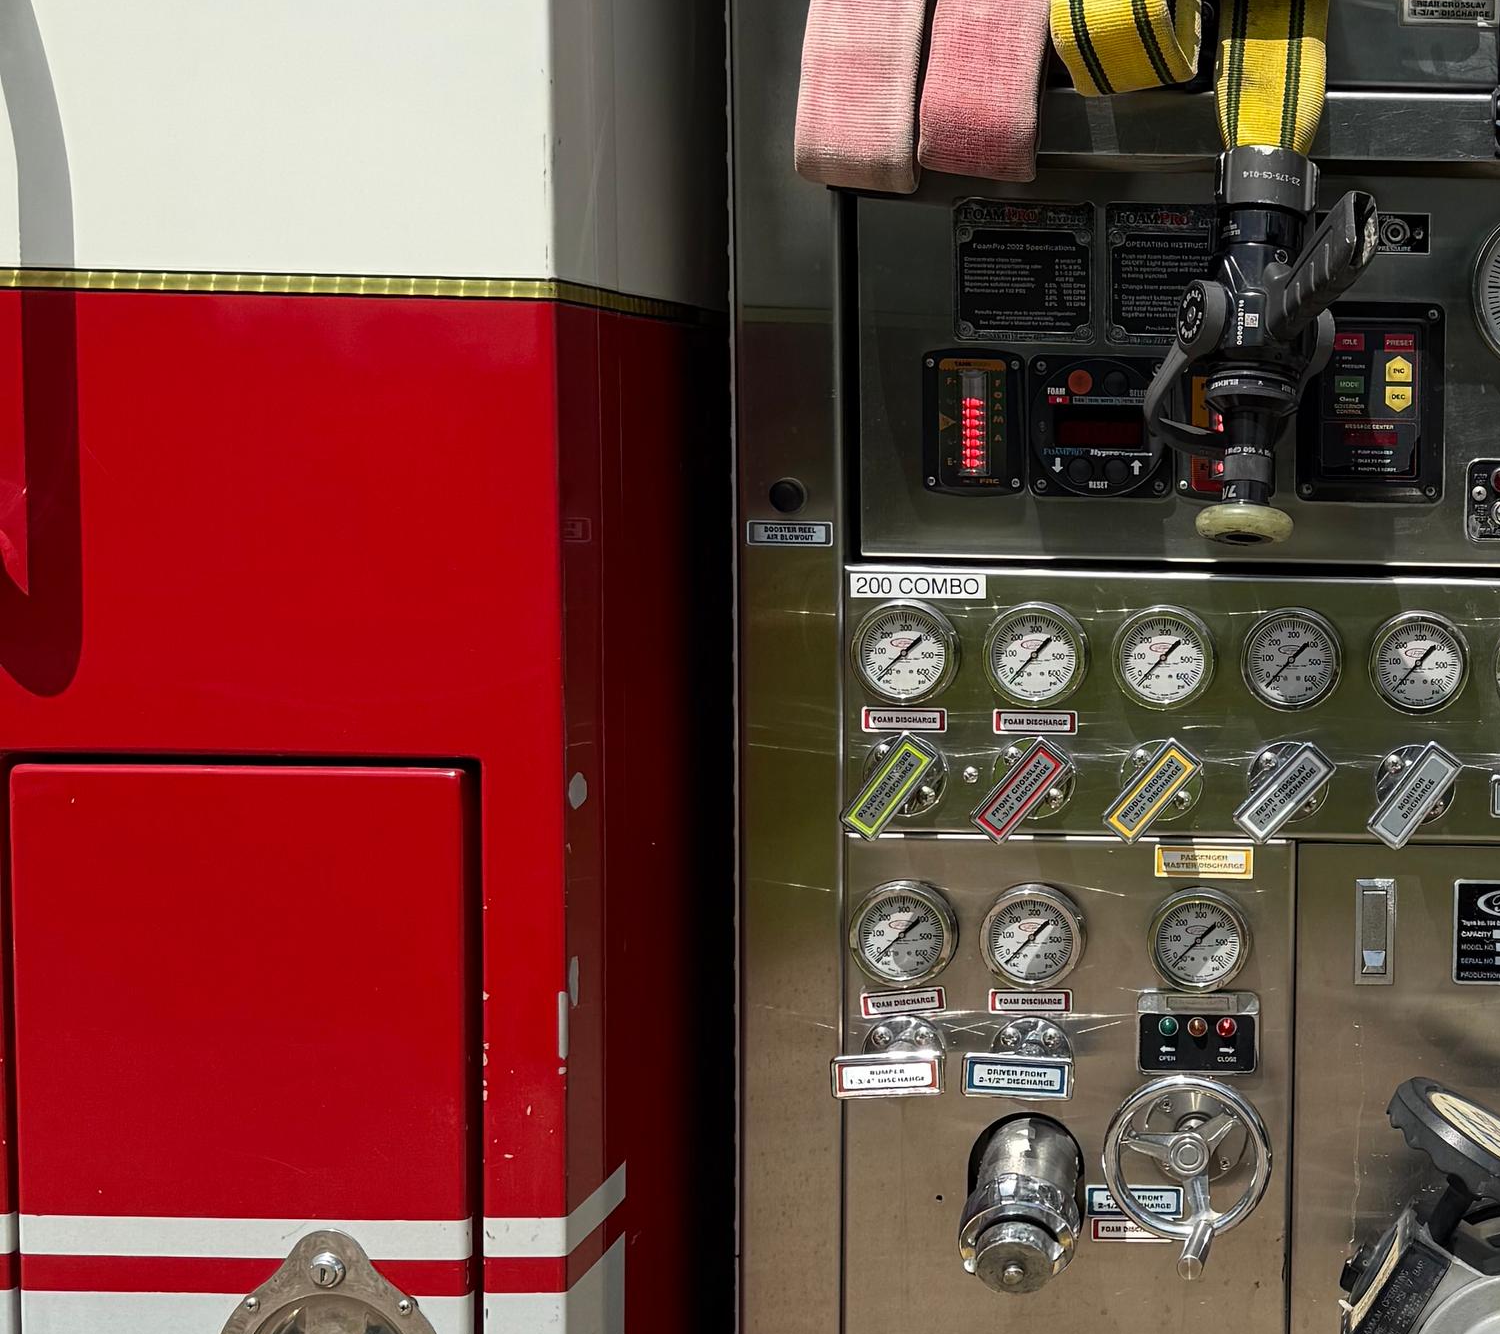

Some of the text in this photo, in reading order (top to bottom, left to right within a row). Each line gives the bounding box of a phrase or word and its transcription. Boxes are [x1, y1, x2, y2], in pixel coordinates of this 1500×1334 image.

[1416, 0, 1487, 9] REAR CROSSLAY
[1439, 9, 1490, 18] DISCHARGE
[1342, 338, 1358, 346] IDLE
[1386, 339, 1413, 347] PRESET
[1392, 367, 1405, 375] INC
[1339, 380, 1360, 389] MODE
[1047, 387, 1066, 396] FOAM
[1391, 393, 1406, 401] DEC
[1089, 481, 1108, 490] RESET
[798, 526, 816, 534] REEL
[856, 577, 979, 596] 200 COMBO
[872, 716, 938, 724] FOAM DISCHARGE
[1026, 718, 1068, 726] DISCHARGE
[885, 761, 915, 799] DISCHARGE
[1016, 765, 1050, 803] DISCHARGE
[1147, 765, 1182, 803] DISCHARGE
[991, 759, 1043, 818] FRONT CROSSLAY
[1121, 759, 1176, 819] MIDDLE CROSSLAY
[1255, 765, 1307, 816] REAR CROSSLAY
[1278, 767, 1317, 806] DISCHARGE
[858, 778, 889, 818] PASSENGER
[1398, 777, 1427, 811] MONITOR
[1402, 779, 1435, 819] DISCHARGE
[1180, 854, 1228, 862] PASSENGER
[1164, 861, 1245, 870] MASTER DISCHARGE
[1461, 930, 1491, 938] CAPACITY
[871, 996, 936, 1009] FOAM DISCHARGE
[999, 998, 1063, 1006] FOAM DISCHARGE
[869, 1068, 906, 1076] BUMPER
[987, 1068, 1047, 1078] DRIVER FRONT
[878, 1076, 926, 1085] DISCHARGE
[1007, 1078, 1055, 1087] DISCHARGE
[1101, 1225, 1122, 1233] FOAM
